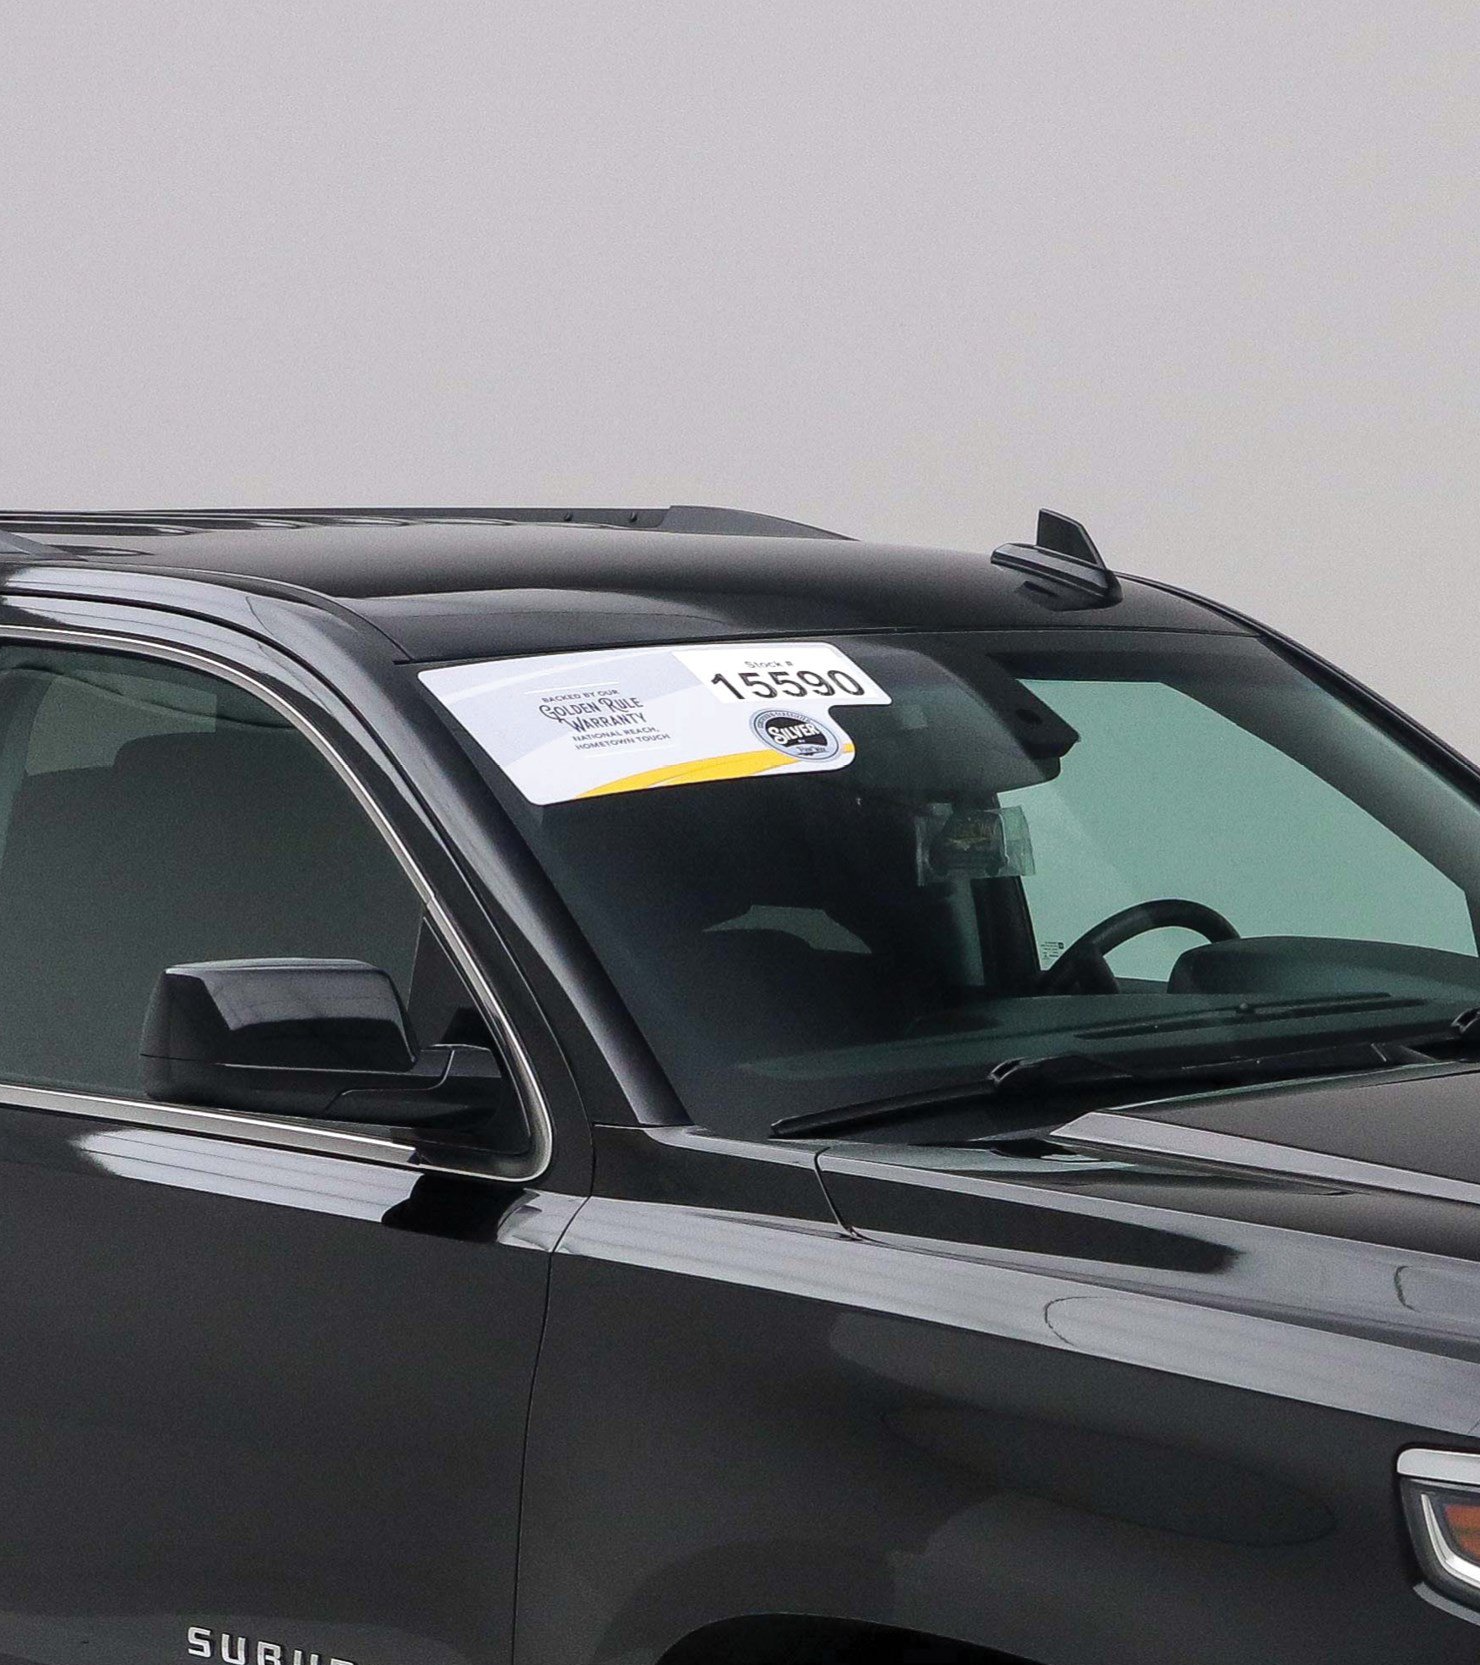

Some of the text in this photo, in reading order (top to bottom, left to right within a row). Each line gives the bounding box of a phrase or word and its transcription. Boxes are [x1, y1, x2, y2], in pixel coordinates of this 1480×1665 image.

[711, 669, 866, 700] 15590
[541, 693, 581, 704] BACKED
[539, 697, 644, 722] GOLDEN RULE
[571, 712, 647, 733] WARRANTY
[572, 730, 622, 742] NATIONAL
[767, 723, 820, 745] SILVER
